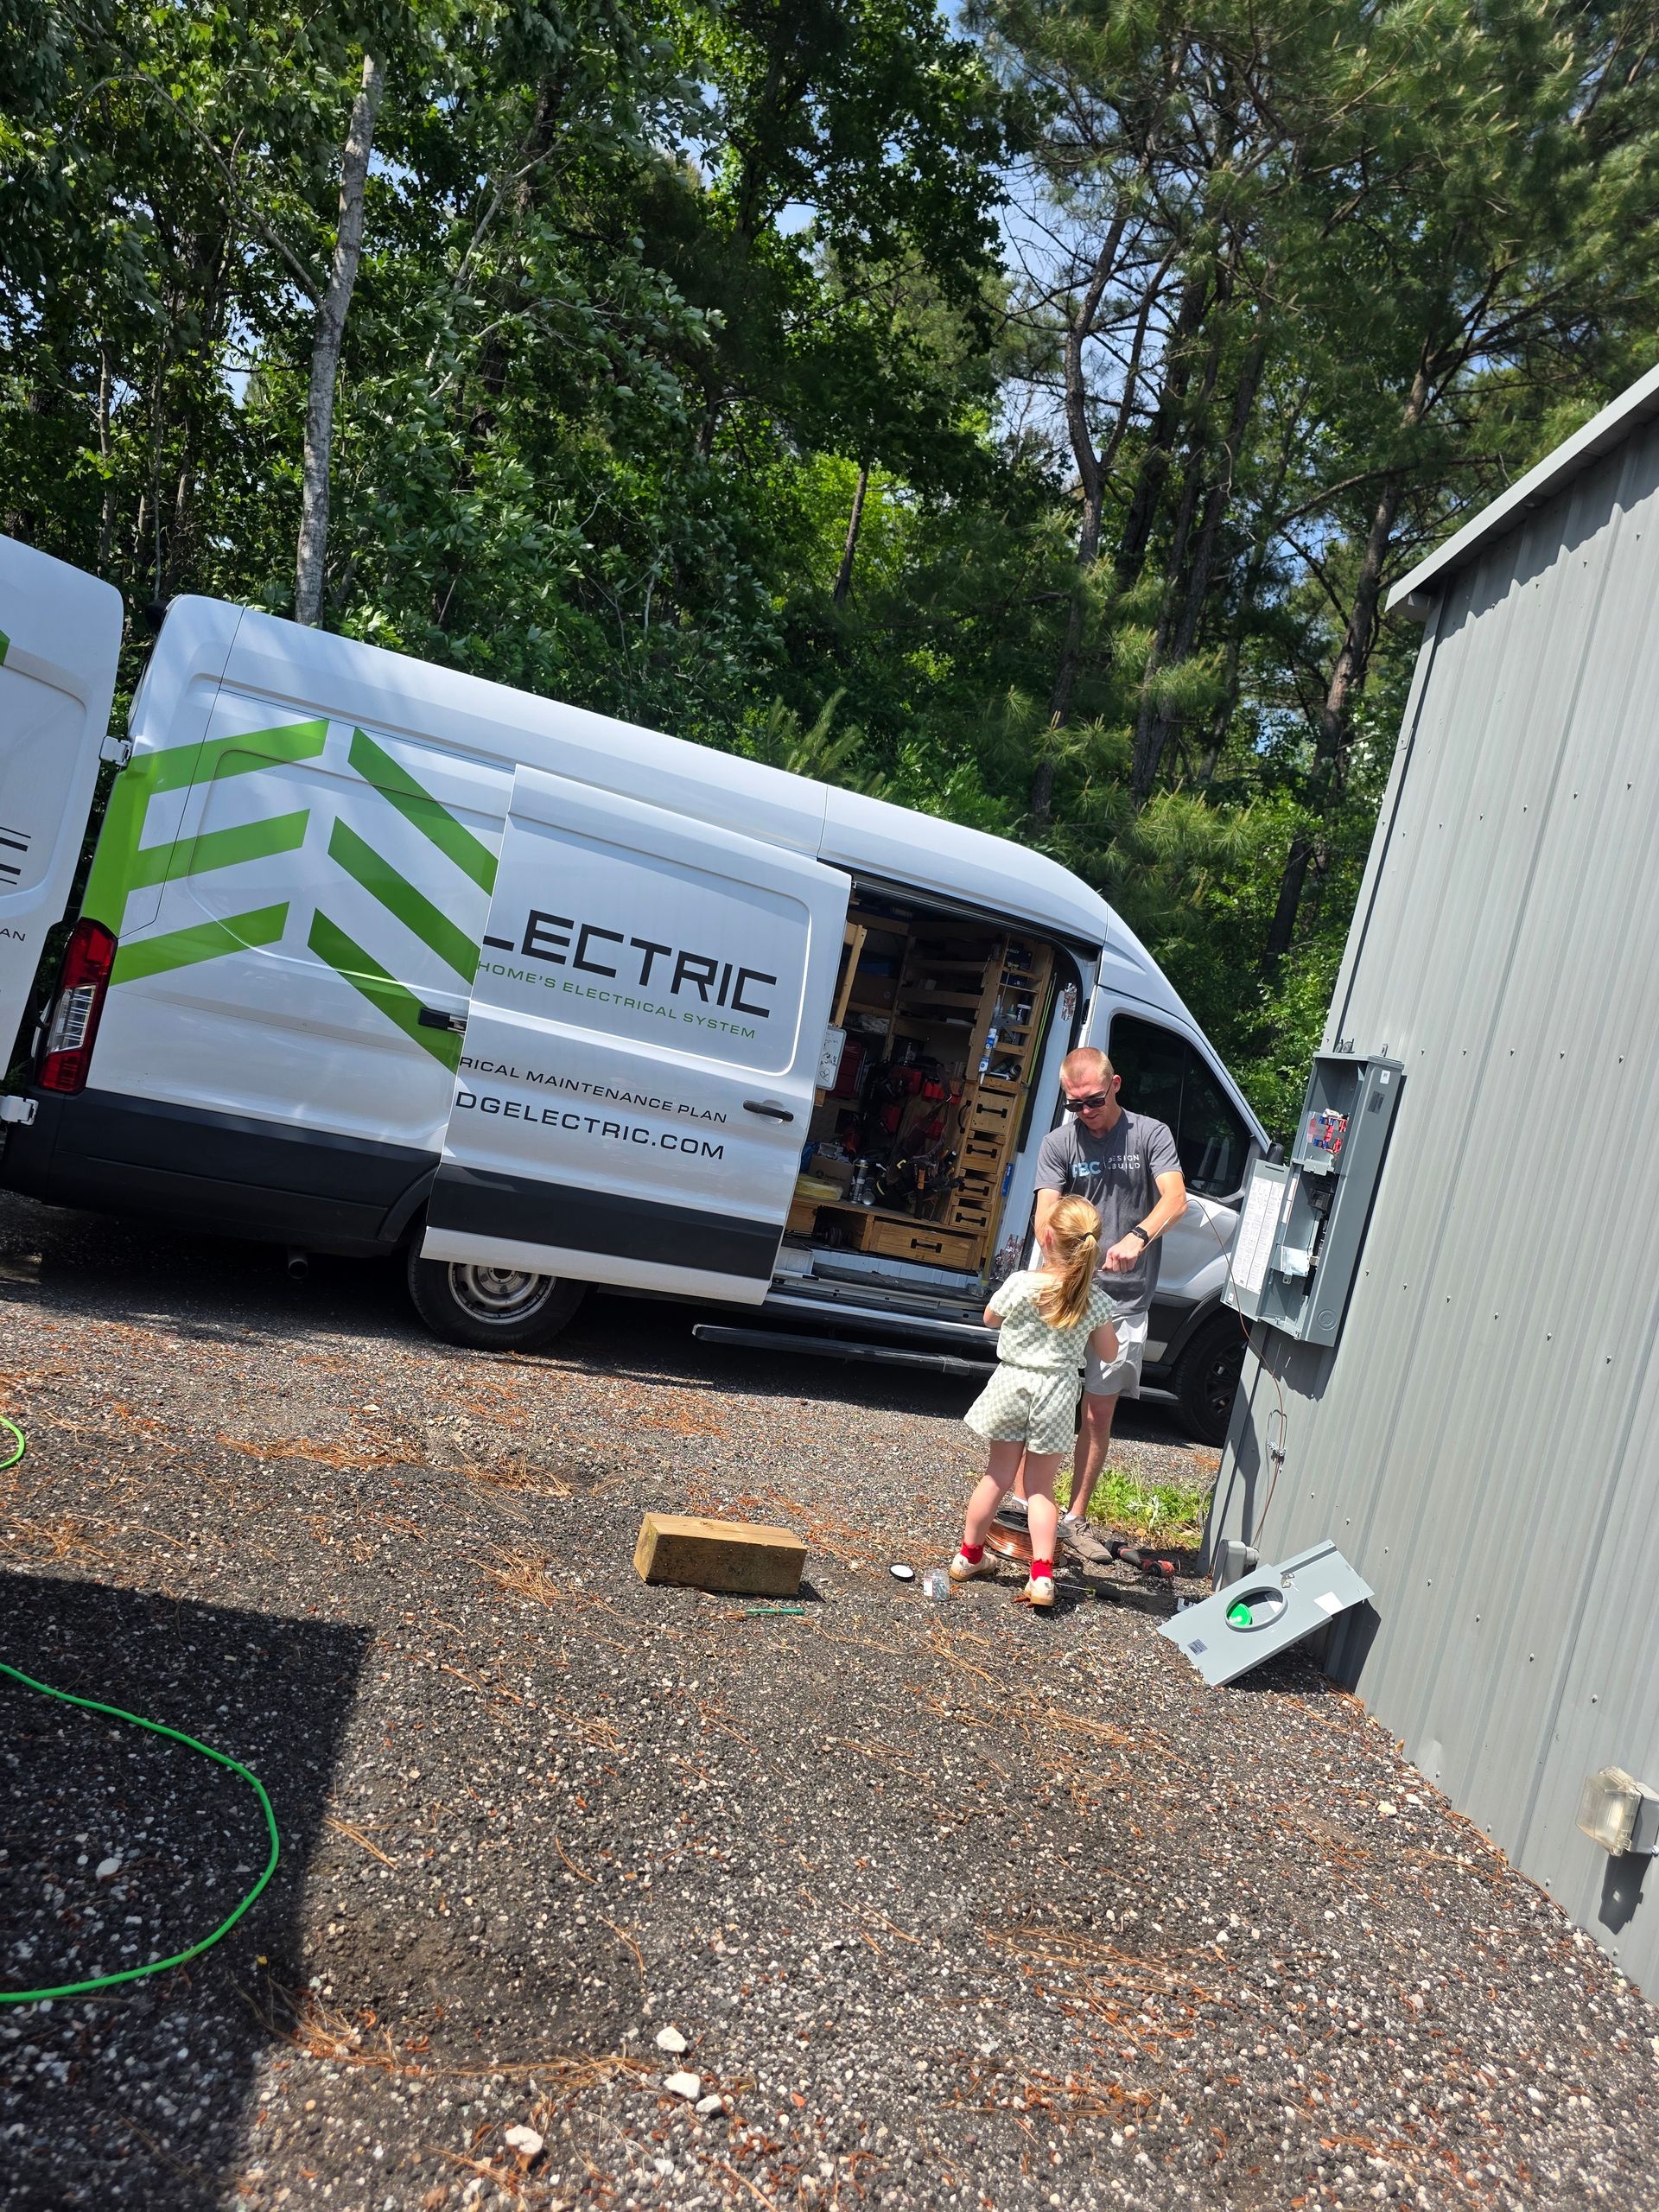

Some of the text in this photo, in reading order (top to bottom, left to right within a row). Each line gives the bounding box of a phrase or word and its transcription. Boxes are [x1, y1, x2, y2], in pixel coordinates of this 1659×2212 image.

[477, 960, 756, 1039] HOME'S ELECTRICAL SYSTEM
[460, 1056, 728, 1124] RICAL MAINTENANCE PLAN
[455, 1091, 725, 1160] DGELECTRIC.COM
